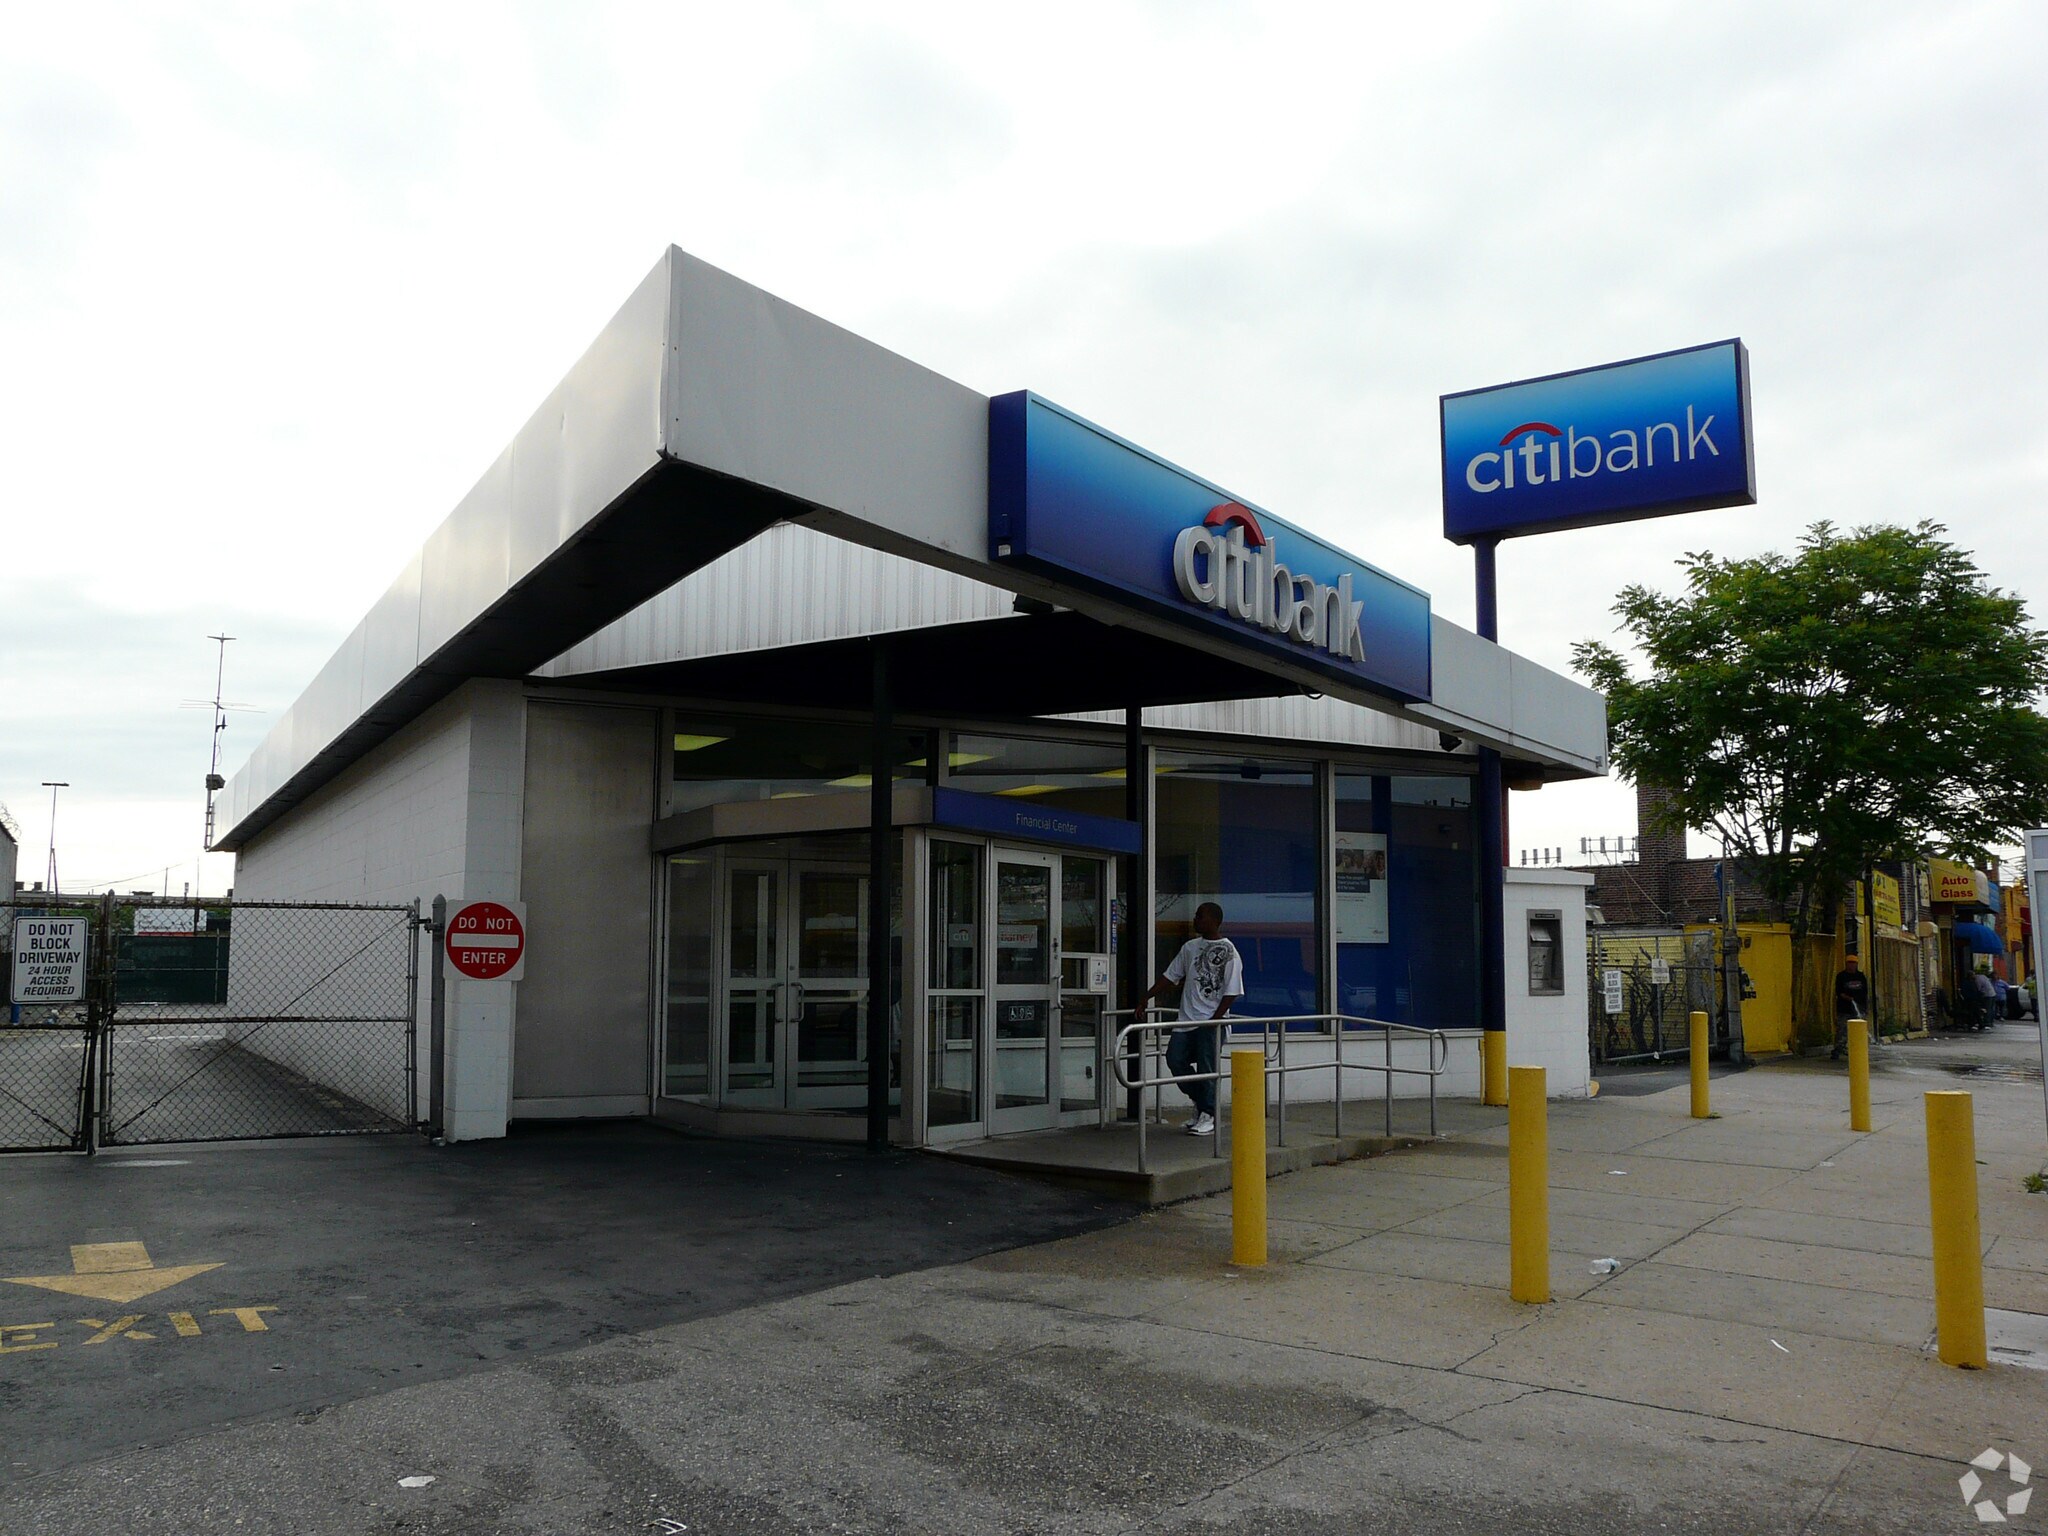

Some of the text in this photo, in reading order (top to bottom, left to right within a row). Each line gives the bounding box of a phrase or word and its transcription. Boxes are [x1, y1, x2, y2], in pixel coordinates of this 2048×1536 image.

[1466, 404, 1720, 493] citibank
[1173, 504, 1366, 662] citibank
[1016, 812, 1078, 834] Financial Center
[1941, 876, 1969, 886] Auto
[1940, 889, 1974, 898] Glass
[28, 924, 75, 936] DO NOT
[458, 917, 514, 931] DO NOT
[30, 938, 71, 950] BLOCK
[19, 952, 81, 964] DRIVEWAY
[462, 951, 506, 965] ENTER
[28, 966, 72, 975] 24 HOUR
[29, 976, 70, 985] ACCESS
[23, 986, 75, 996] REQUIRED
[0, 1305, 279, 1353] EXIT
